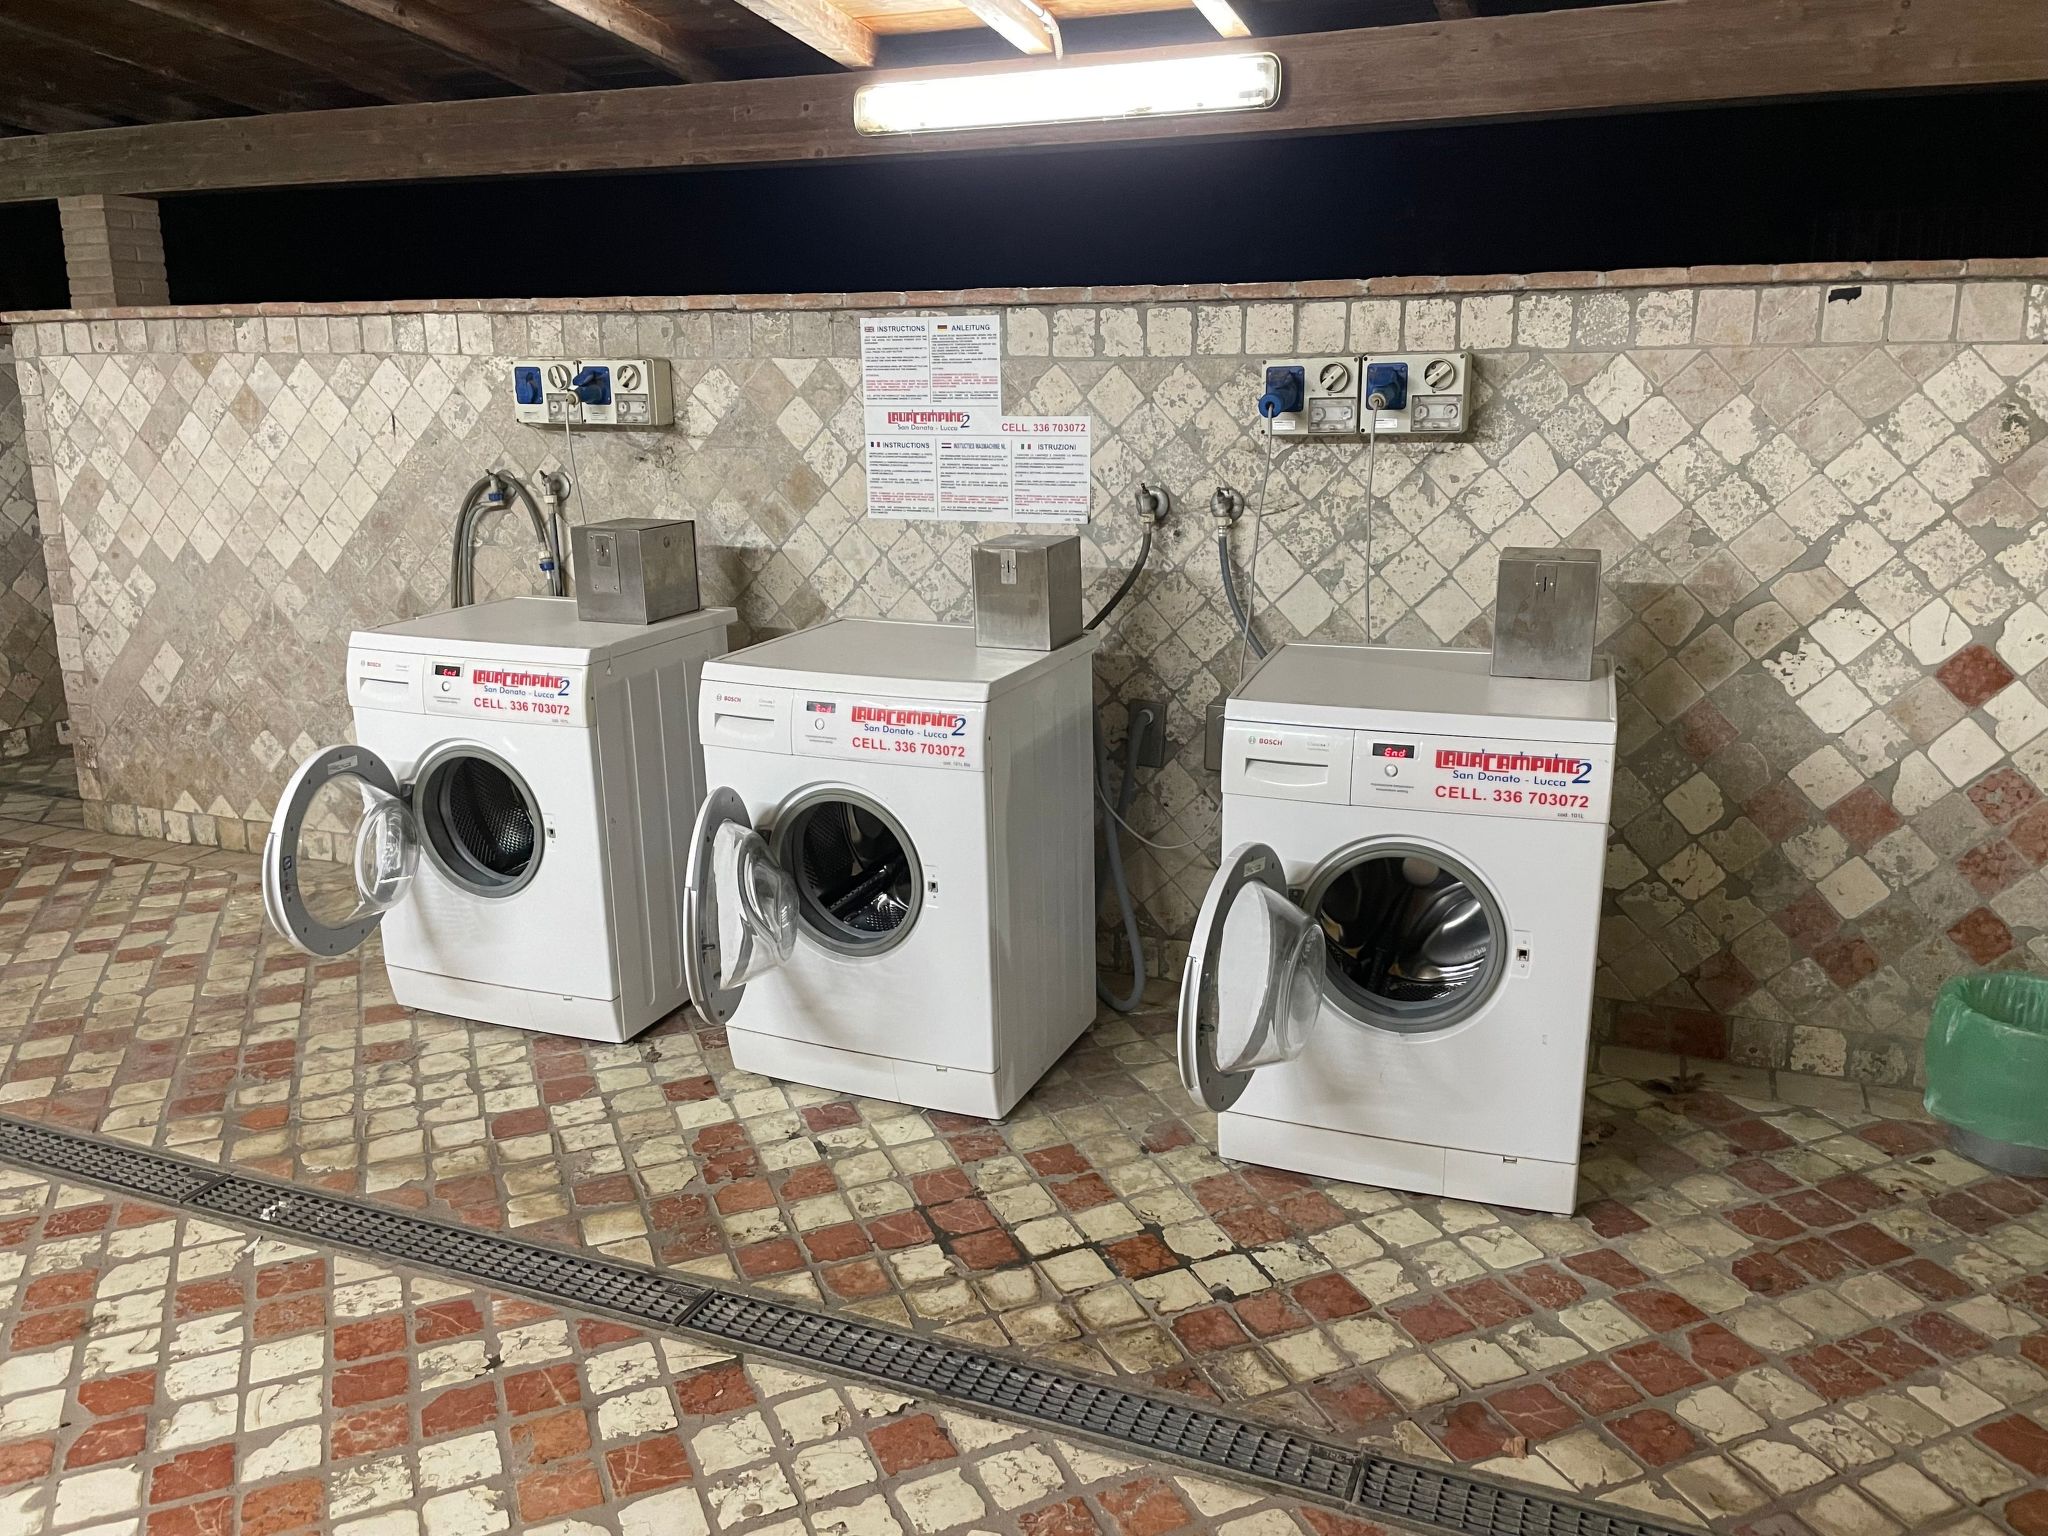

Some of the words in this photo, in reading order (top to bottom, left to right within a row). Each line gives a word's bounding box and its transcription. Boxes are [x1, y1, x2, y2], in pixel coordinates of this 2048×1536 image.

[1033, 423, 1050, 432] 336
[1052, 422, 1086, 432] 703072
[1037, 443, 1077, 451] ISTRUZIONI
[443, 668, 457, 676] End
[484, 685, 499, 693] San
[499, 687, 527, 696] Donato
[533, 690, 555, 699] Lucca
[557, 679, 571, 696] 2
[474, 697, 507, 710] CELL.
[510, 700, 529, 712] 336
[531, 702, 570, 715] 703072
[815, 704, 833, 713] End
[864, 723, 881, 731] San
[882, 725, 914, 736] Donato
[923, 730, 948, 739] Lucca
[951, 717, 966, 736] 2
[852, 737, 891, 751] CELL.
[894, 740, 917, 753] 336
[920, 743, 966, 758] 703072
[1259, 738, 1283, 746] BOSCH
[1384, 747, 1406, 758] End
[1452, 770, 1474, 780] San
[1478, 772, 1521, 784] Donato
[1534, 776, 1567, 787] Lucca
[1571, 762, 1593, 784] 2
[1435, 785, 1487, 801] CELL.
[1493, 789, 1523, 803] 336
[1528, 792, 1589, 808] 703072
